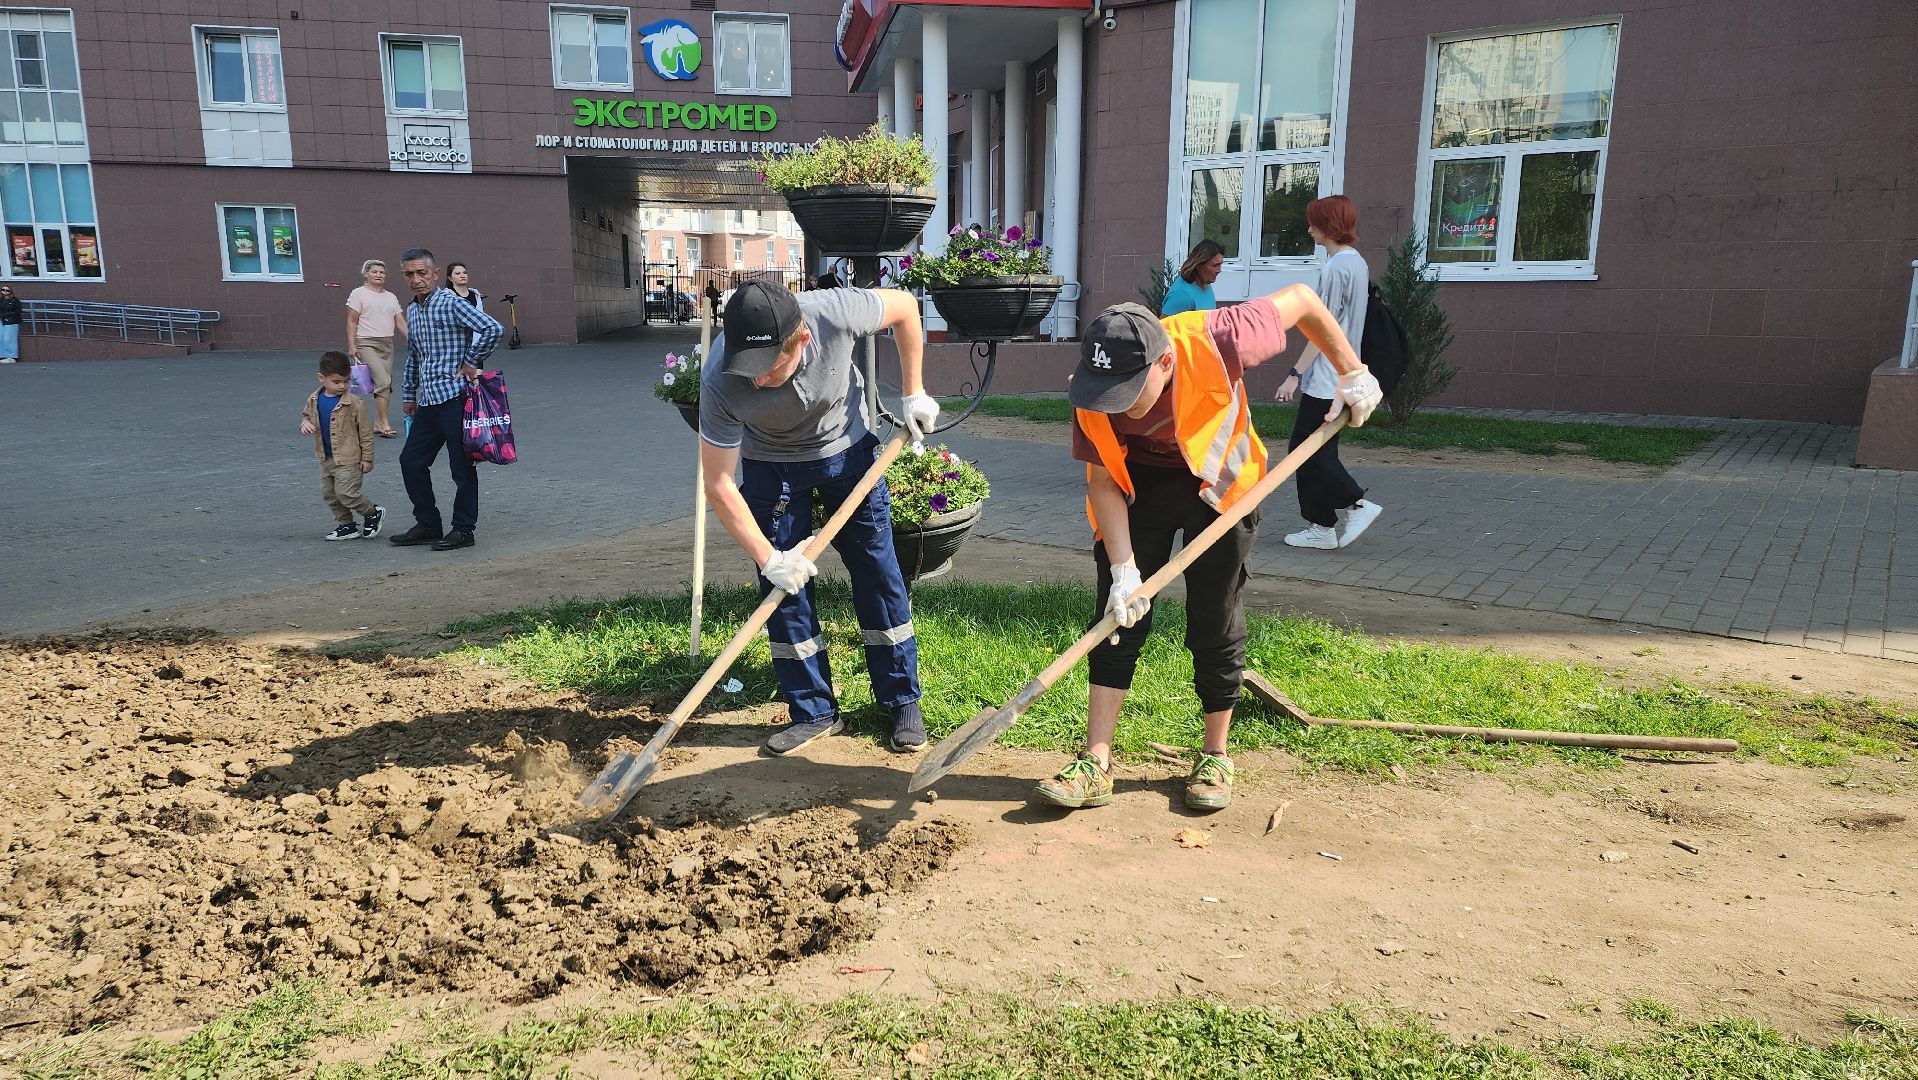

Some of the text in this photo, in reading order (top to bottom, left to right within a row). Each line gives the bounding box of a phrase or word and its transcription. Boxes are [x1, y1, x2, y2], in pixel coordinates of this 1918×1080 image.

[572, 98, 777, 132] ЭКСТРОMED
[405, 132, 449, 146] Класс
[535, 135, 560, 147] ЛОР
[563, 136, 572, 147] И
[575, 136, 669, 150] СТОМАТОЛОГИЯ
[672, 139, 697, 152] ДЛЯ
[701, 138, 736, 153] ДЕТЕЙ
[740, 141, 748, 152] И
[388, 150, 408, 161] на
[1442, 222, 1495, 233] Кредитка
[1092, 342, 1111, 369] LA
